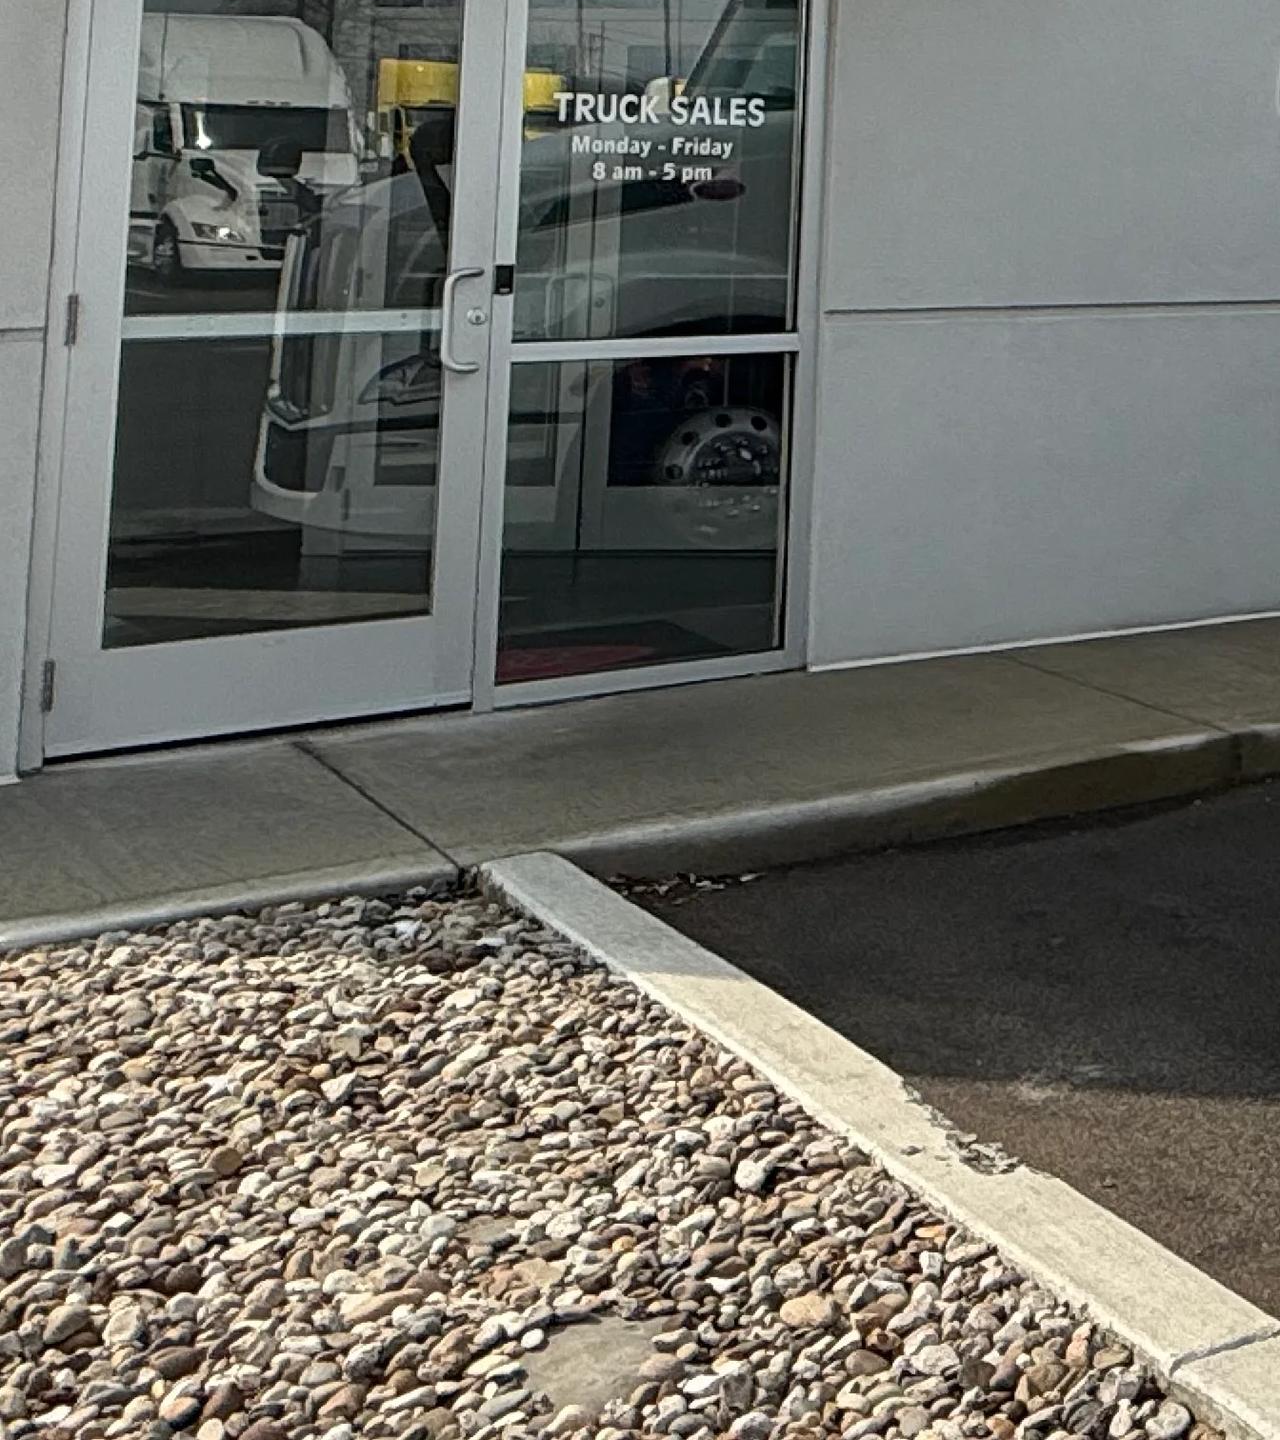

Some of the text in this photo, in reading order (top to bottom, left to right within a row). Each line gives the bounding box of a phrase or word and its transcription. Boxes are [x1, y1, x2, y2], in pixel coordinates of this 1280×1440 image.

[553, 92, 766, 127] TRUCK SALES
[571, 135, 651, 158] Monday
[671, 137, 733, 159] Friday
[592, 163, 607, 180] 8
[612, 166, 642, 180] am
[662, 163, 676, 180] 5
[682, 166, 713, 182] pm
